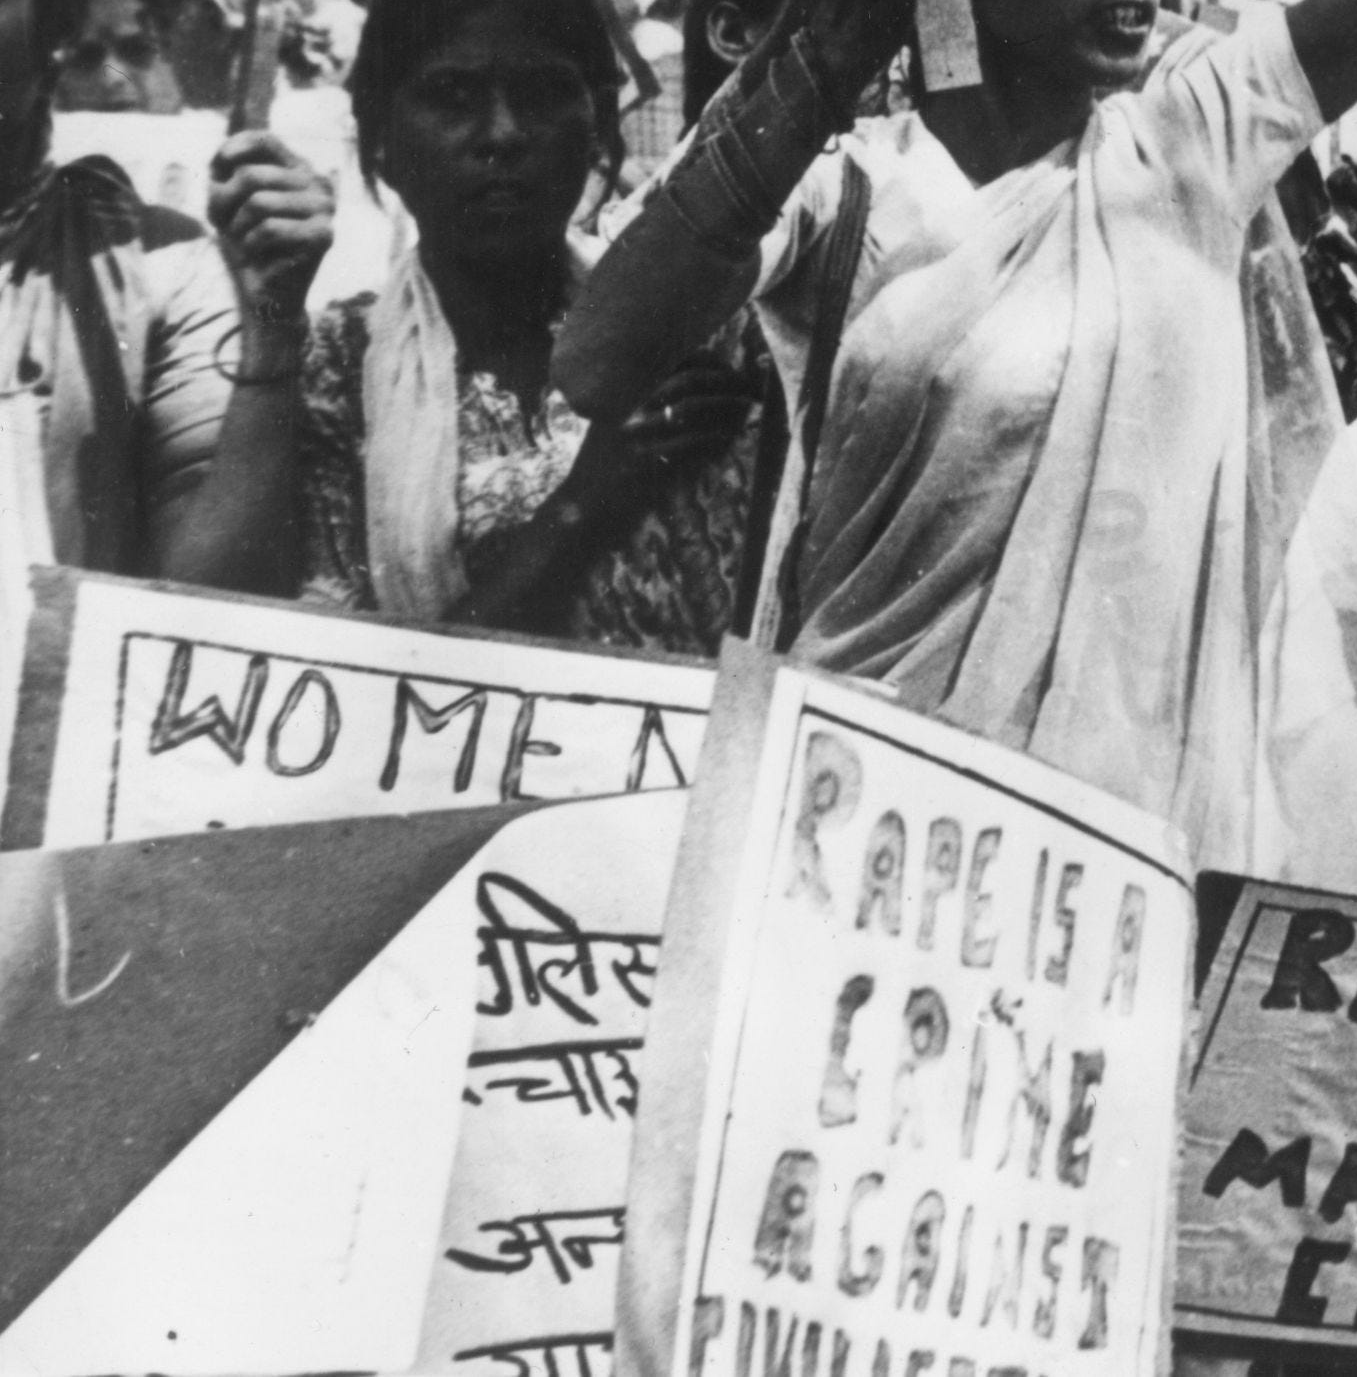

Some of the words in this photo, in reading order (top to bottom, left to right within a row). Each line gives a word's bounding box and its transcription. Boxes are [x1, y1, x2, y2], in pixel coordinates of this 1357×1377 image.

[786, 730, 1002, 967] RAPE
[1026, 847, 1084, 985] IS
[1101, 883, 1146, 1014] A
[818, 974, 1106, 1188] CRIME
[752, 1150, 1119, 1351] AGAINST
